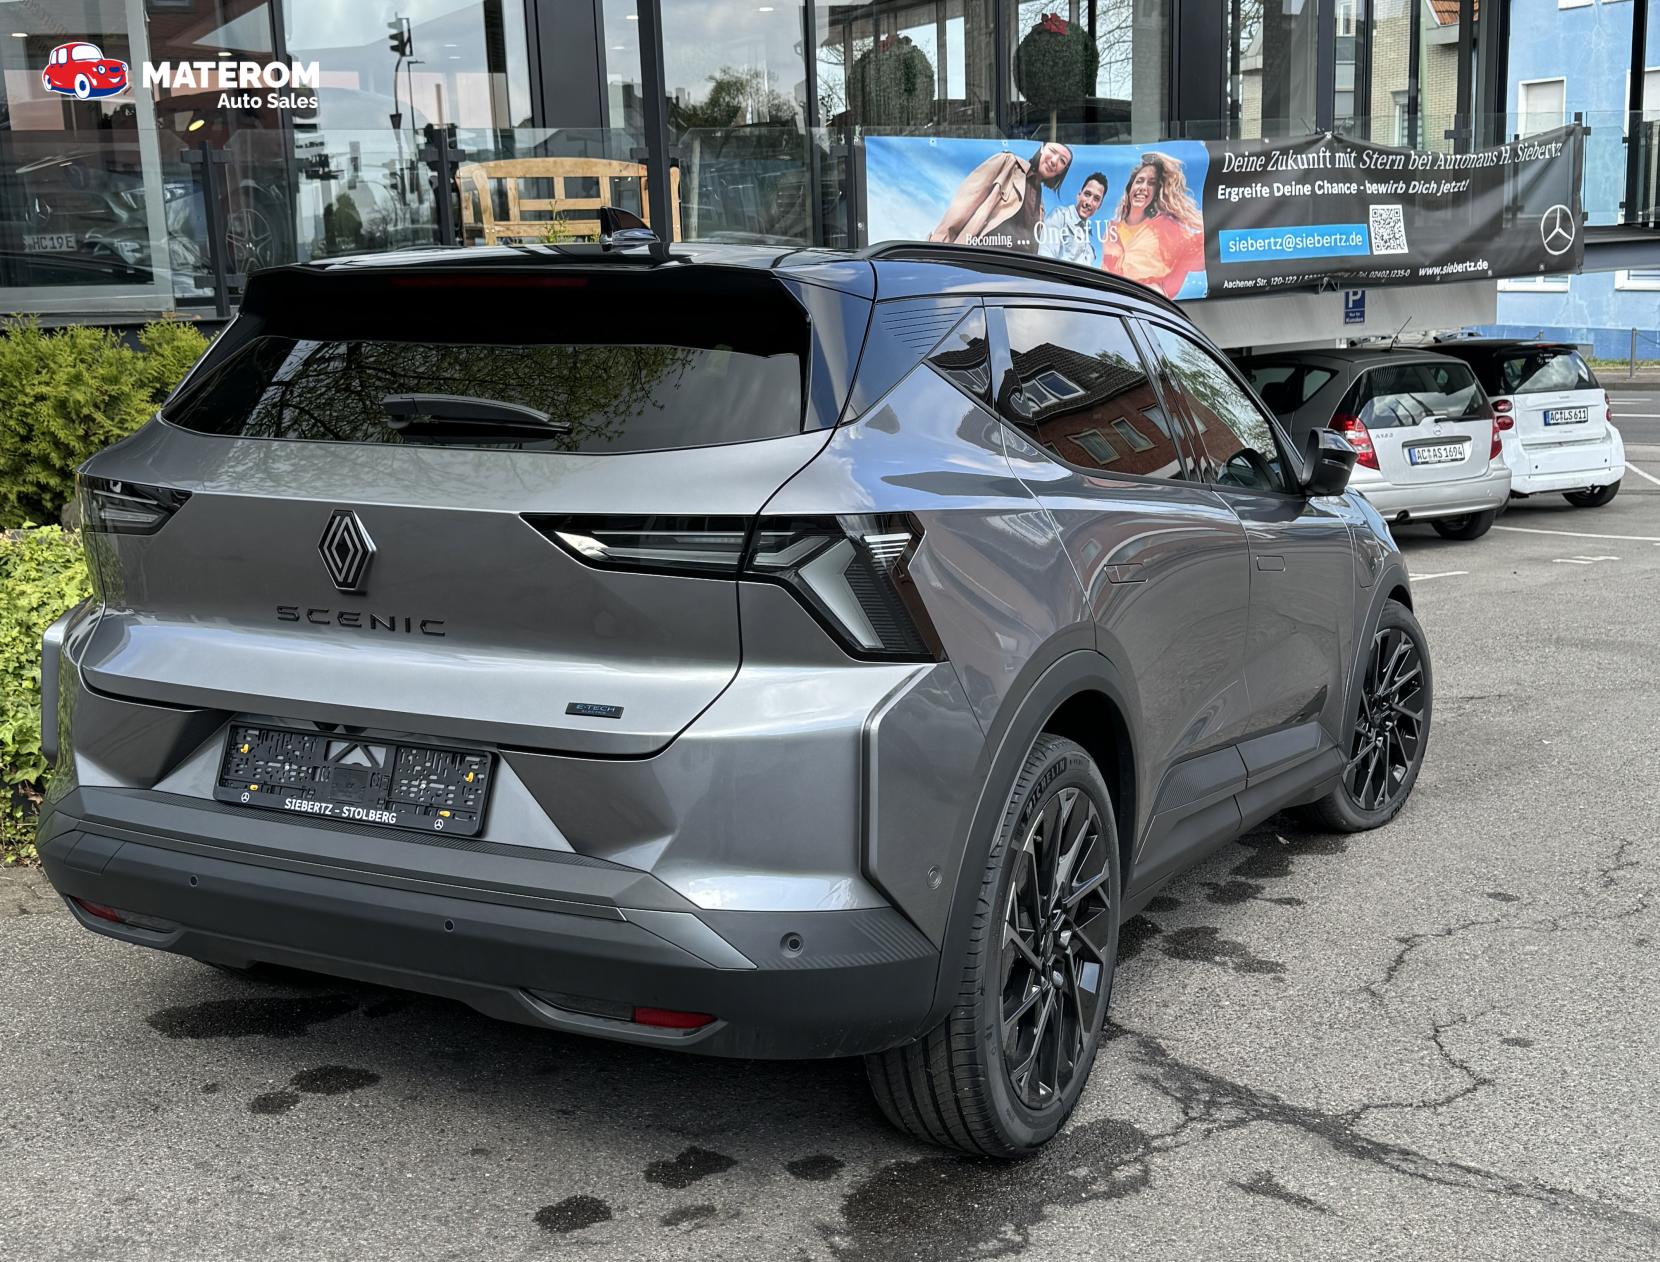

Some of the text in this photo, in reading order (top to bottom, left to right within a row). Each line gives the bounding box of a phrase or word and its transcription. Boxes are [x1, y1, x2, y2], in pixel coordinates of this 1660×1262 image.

[1222, 151, 1266, 173] Deine
[1267, 147, 1332, 171] Zukunft
[1335, 148, 1357, 169] mit
[1359, 150, 1405, 170] Stern
[1408, 151, 1432, 170] bei
[1499, 146, 1512, 165] H.
[1515, 141, 1563, 163] Siebertz
[1217, 183, 1270, 202] Ergreife
[1273, 181, 1311, 197] Deine
[1315, 180, 1357, 195] Chance
[1365, 180, 1406, 195] bewirb
[1408, 180, 1437, 195] Dich
[1437, 179, 1470, 197] jetzt!
[965, 233, 1013, 248] Becoming
[1034, 221, 1066, 245] One
[1074, 221, 1091, 243] of
[1096, 220, 1118, 243] Us
[1228, 231, 1363, 252] siebertz@siebertz.de
[1419, 259, 1488, 276] www.siebertz.de
[1223, 278, 1255, 289] Aachener
[1257, 277, 1268, 287] Str.
[1270, 276, 1297, 286] 120-122
[1348, 289, 1362, 308] P
[1551, 409, 1586, 421] AC LS 611
[1417, 446, 1463, 460] AC AS 1694
[276, 605, 446, 637] SCENIC
[284, 798, 334, 815] SIEBERTZ
[341, 806, 397, 824] STOLBERG
